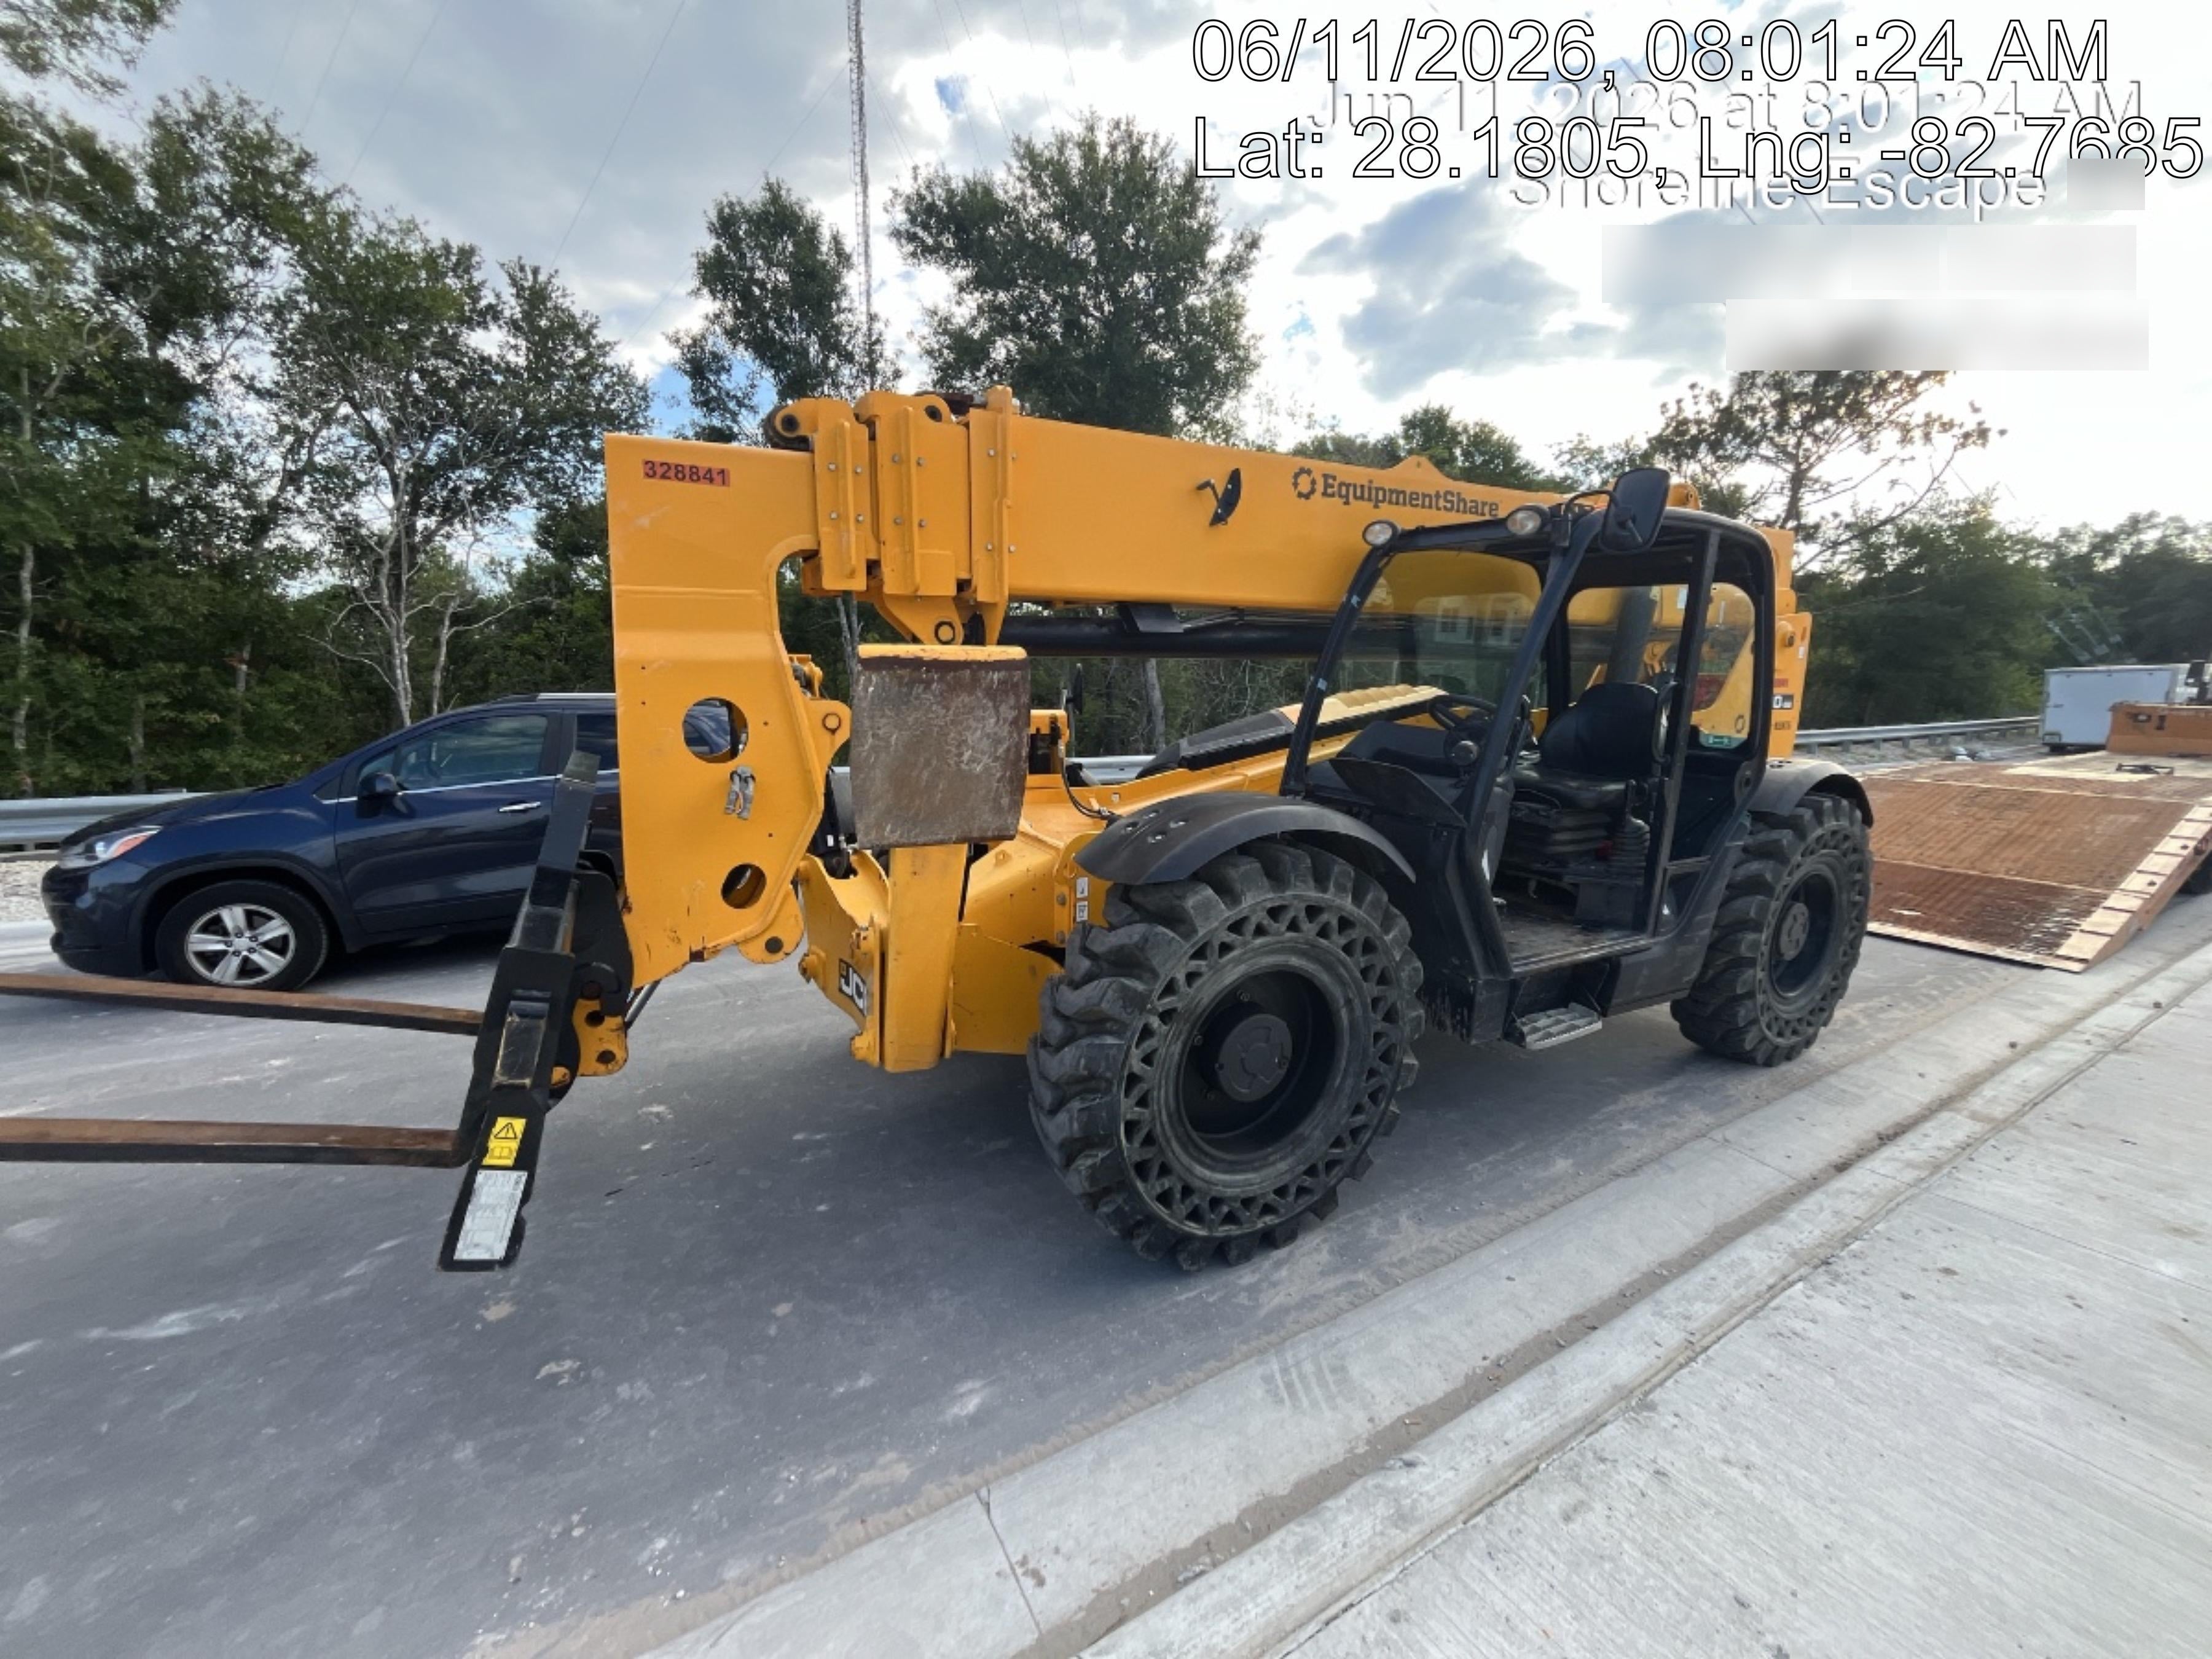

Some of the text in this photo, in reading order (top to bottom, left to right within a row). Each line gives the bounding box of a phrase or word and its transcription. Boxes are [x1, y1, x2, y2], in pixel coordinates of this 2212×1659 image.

[644, 460, 727, 486] 328841
[1321, 472, 1500, 517] EquipmentShare
[839, 965, 867, 1016] JC
